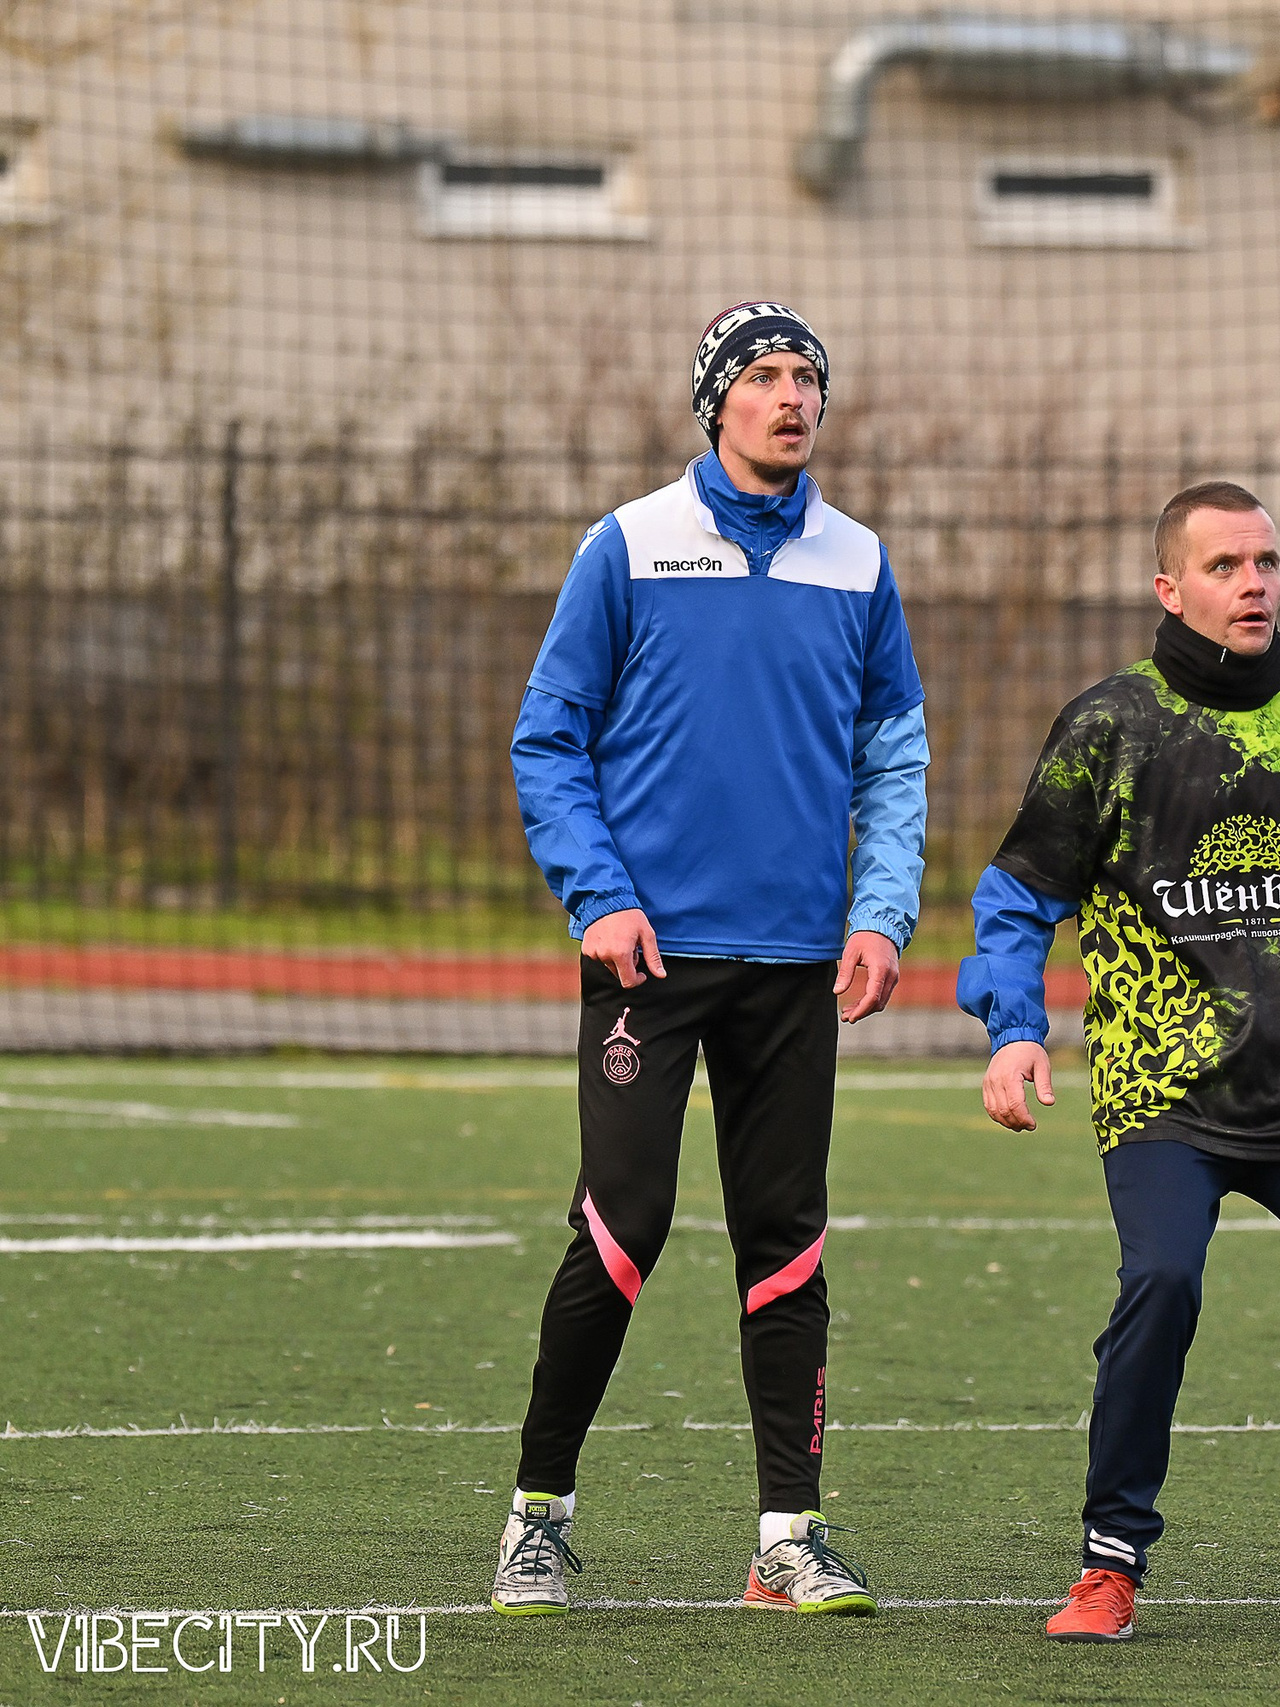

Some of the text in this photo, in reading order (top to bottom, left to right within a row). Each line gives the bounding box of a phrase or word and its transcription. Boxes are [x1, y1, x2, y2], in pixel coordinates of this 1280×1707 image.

[653, 556, 722, 572] macron
[1245, 917, 1267, 926] 1871
[608, 1046, 633, 1057] PARIS
[810, 1366, 826, 1454] PARIS
